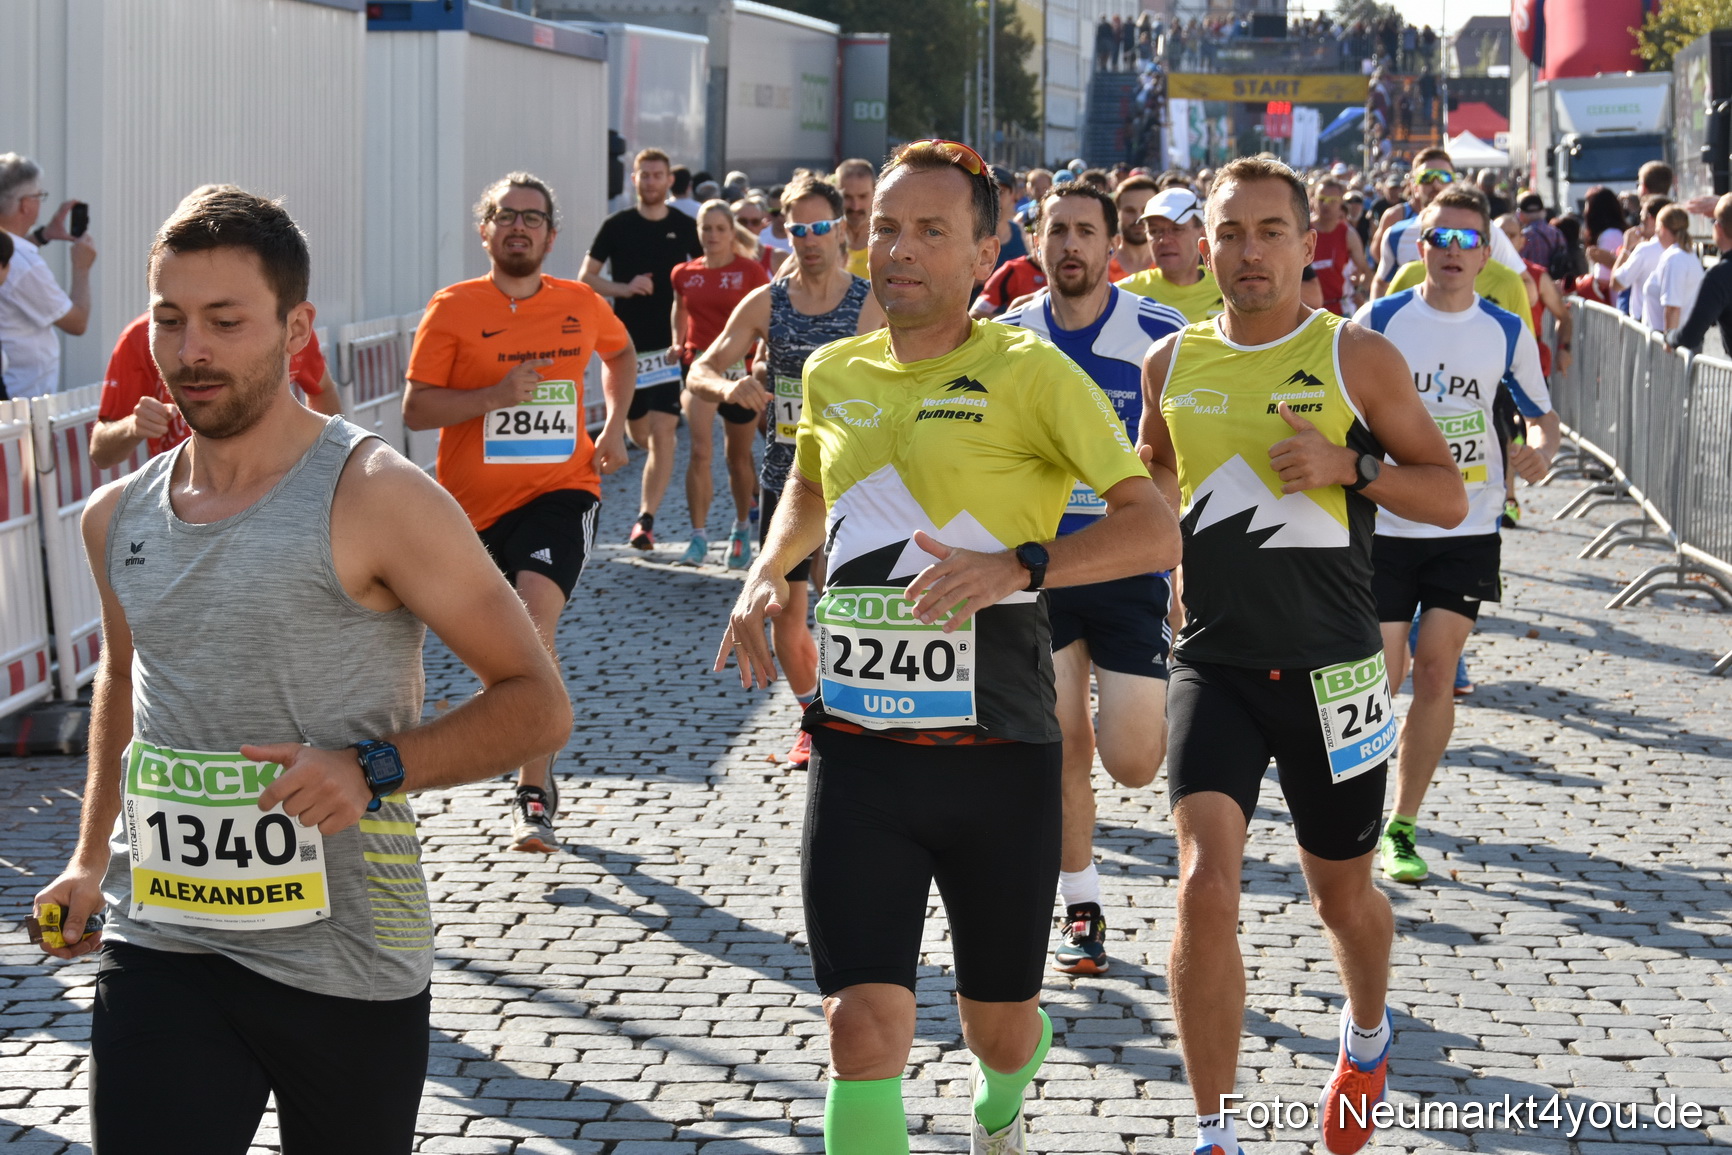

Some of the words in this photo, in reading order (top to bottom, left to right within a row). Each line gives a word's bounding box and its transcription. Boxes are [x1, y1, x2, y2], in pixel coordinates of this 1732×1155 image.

[1232, 79, 1302, 97] START
[497, 352, 506, 362] It
[507, 350, 537, 363] might
[558, 347, 581, 358] fast!
[1270, 389, 1326, 401] Kettenbach
[915, 409, 984, 424] Runners
[1193, 405, 1229, 415] MARX
[1266, 402, 1323, 415] Rnners
[495, 410, 566, 435] 2844
[125, 556, 146, 567] erima
[959, 643, 967, 651] B
[830, 634, 956, 682] 2240
[863, 694, 915, 714] UDO
[146, 811, 297, 868] 1340
[150, 877, 305, 906] ALEXANDER
